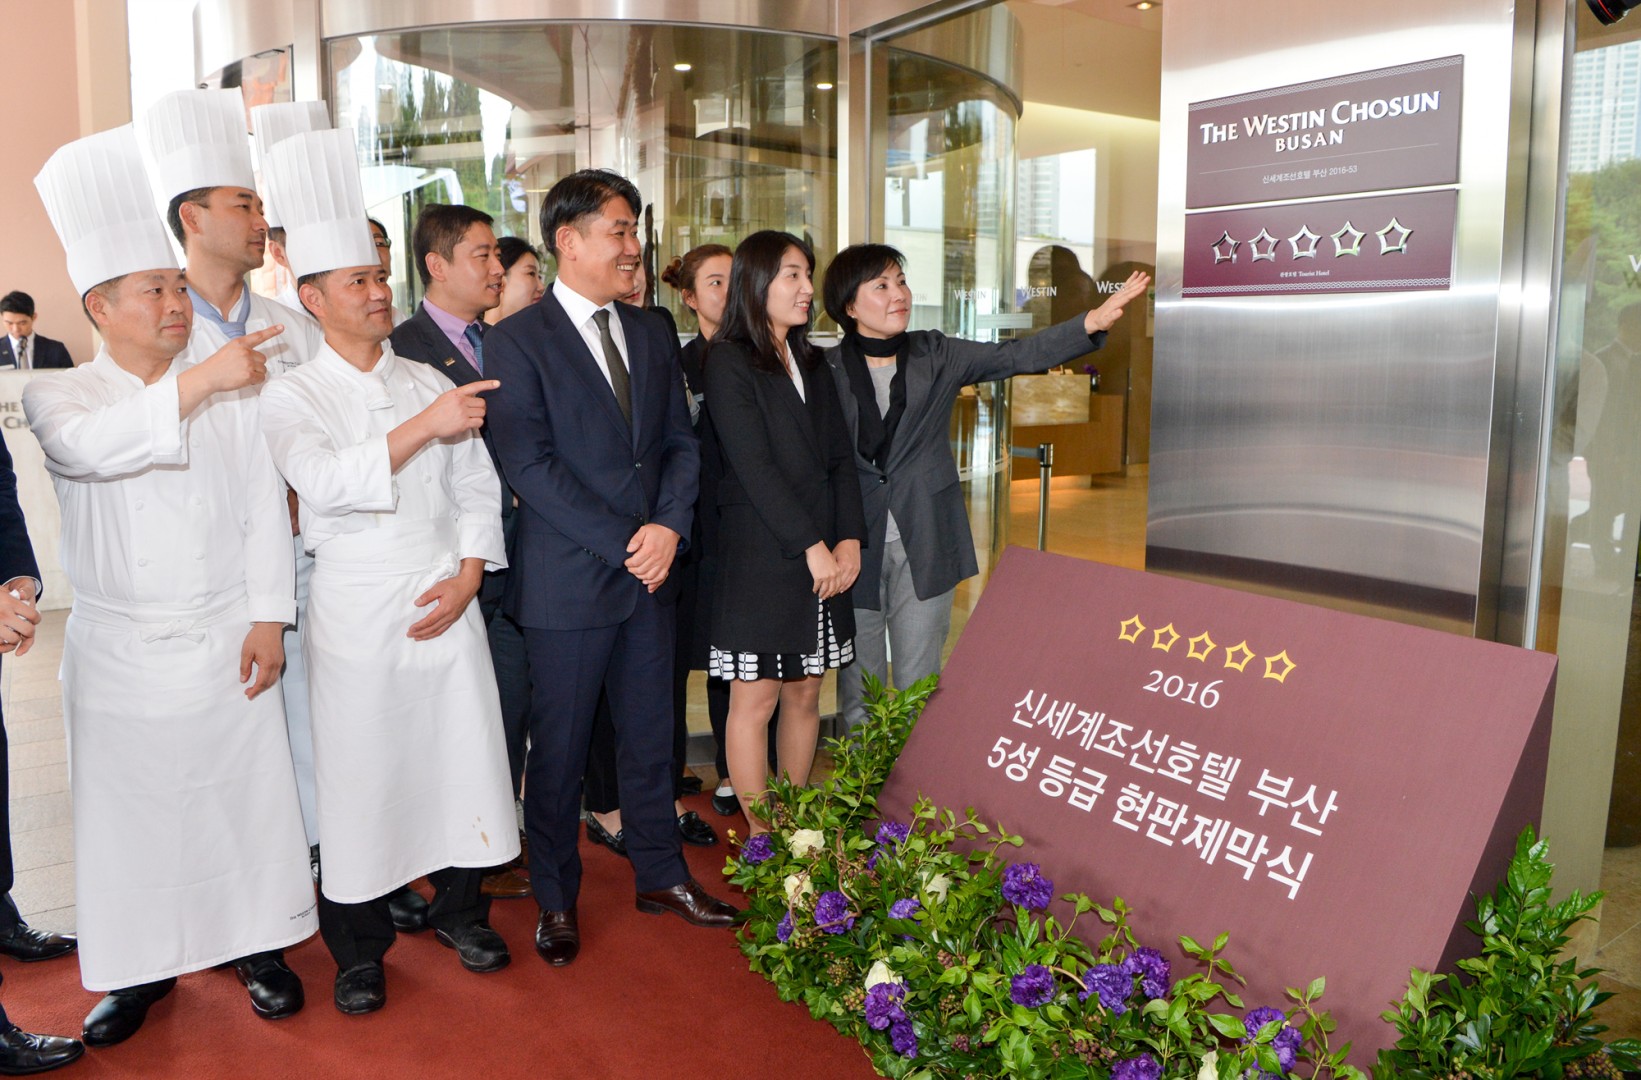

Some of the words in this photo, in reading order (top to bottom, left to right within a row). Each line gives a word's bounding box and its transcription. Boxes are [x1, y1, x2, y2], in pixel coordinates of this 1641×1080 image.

[1200, 122, 1239, 145] THE
[1243, 108, 1326, 137] WESTIN
[1331, 90, 1440, 125] CHOSUN
[1275, 129, 1344, 152] BUSAN
[1262, 169, 1311, 184] 신세계조선호텔
[1312, 168, 1328, 178] 부산
[1328, 165, 1358, 176] 2016-53
[1021, 286, 1058, 298] WESTIN
[1142, 669, 1224, 709] 2016
[1012, 689, 1242, 801] 신세계조선호텔
[1248, 768, 1339, 836] 부산
[987, 736, 1041, 782] 5성
[1038, 754, 1109, 812] 등급
[1112, 782, 1314, 900] 현판제막식
